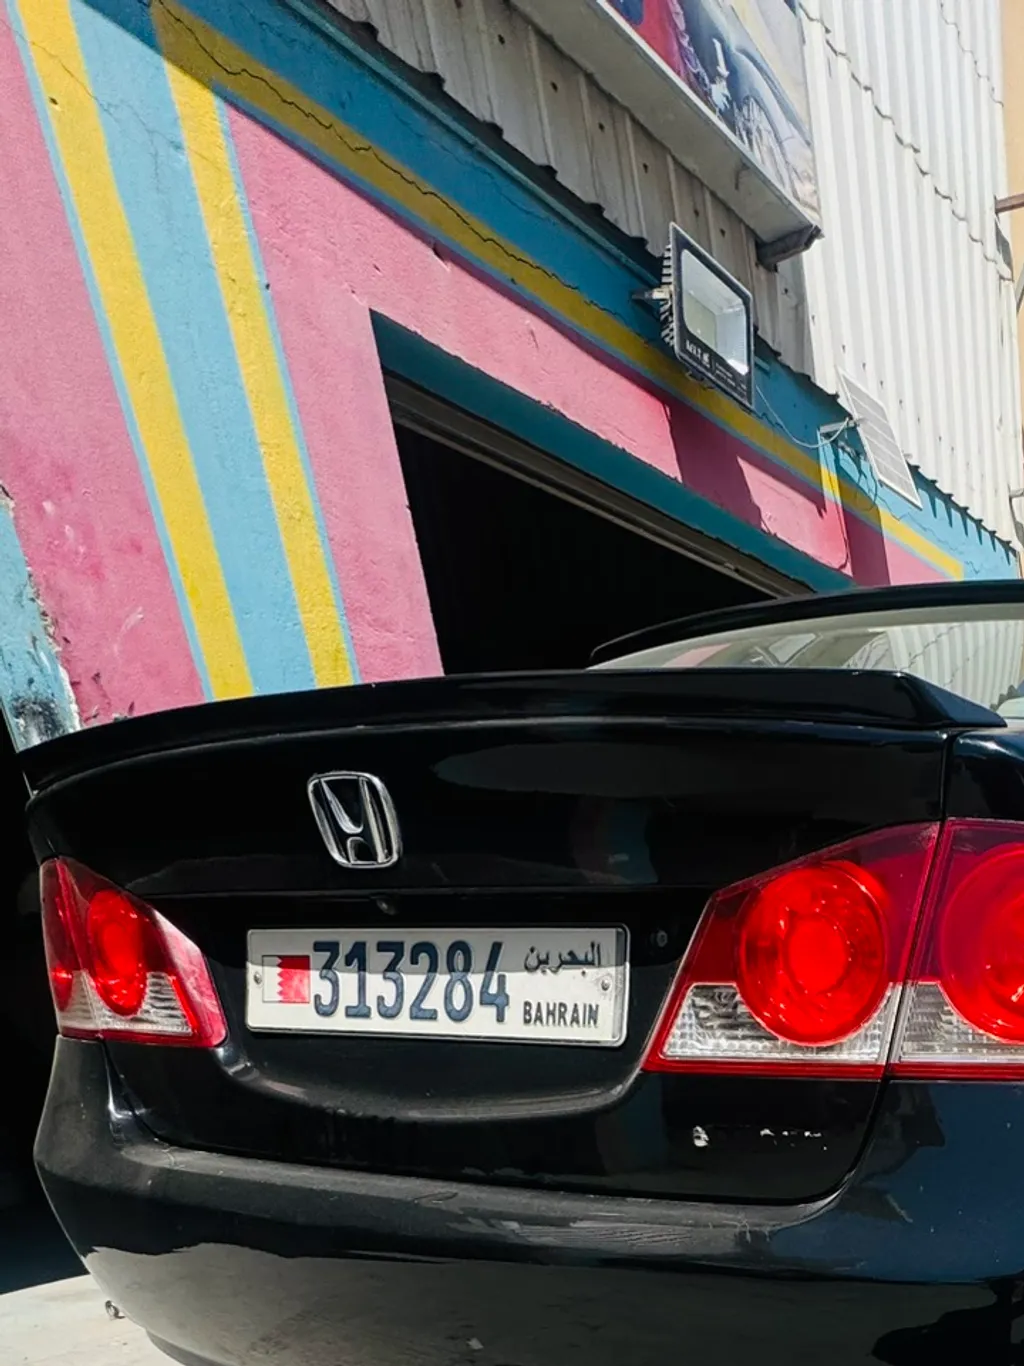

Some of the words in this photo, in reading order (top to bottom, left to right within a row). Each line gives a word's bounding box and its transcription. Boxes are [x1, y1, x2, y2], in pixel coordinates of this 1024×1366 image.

[523, 940, 602, 977] البحرين
[312, 939, 511, 1024] 313284
[522, 1002, 600, 1029] BAHRAIN
